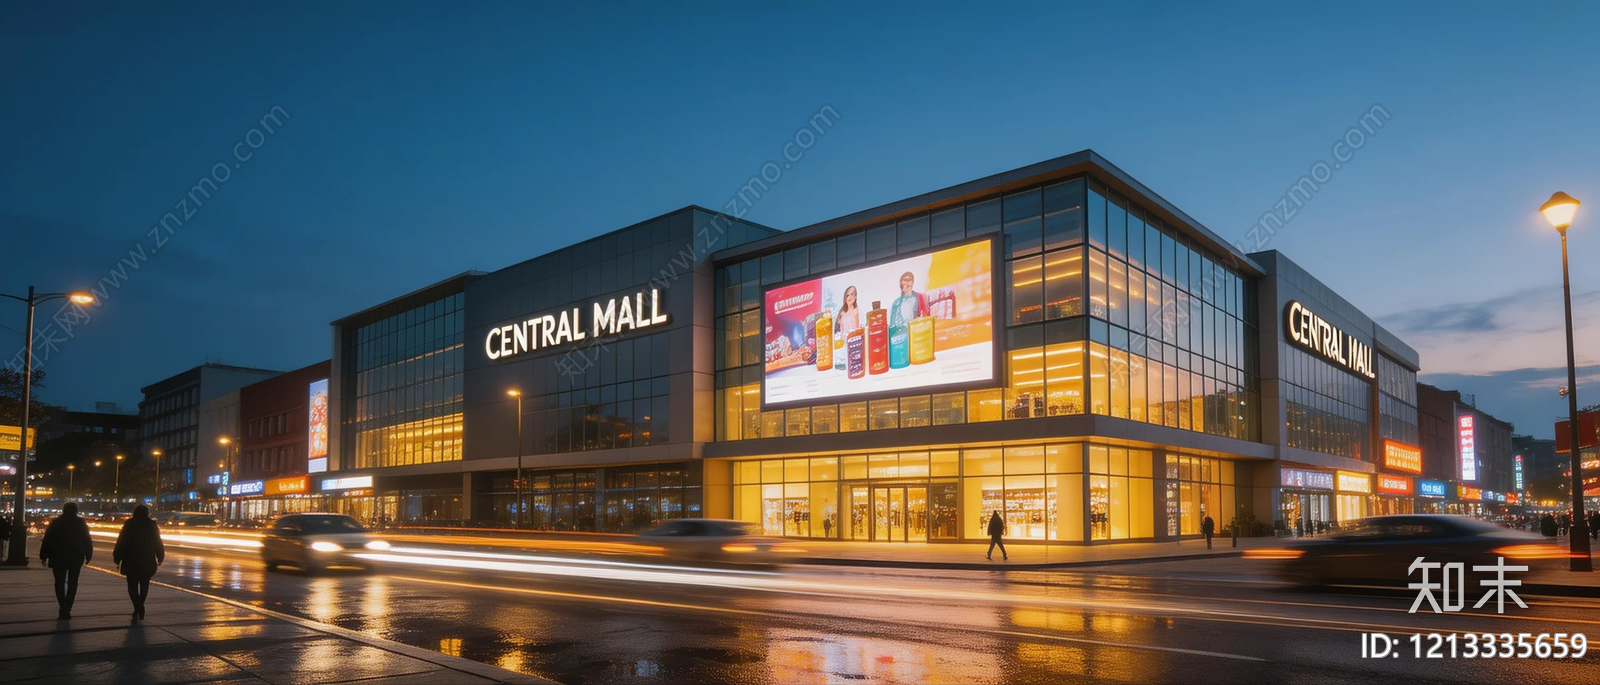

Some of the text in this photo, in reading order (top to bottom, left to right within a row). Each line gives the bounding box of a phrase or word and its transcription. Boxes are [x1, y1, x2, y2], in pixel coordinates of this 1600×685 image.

[485, 289, 667, 360] CENTRAL MALL
[1289, 301, 1346, 366] CENTRAL
